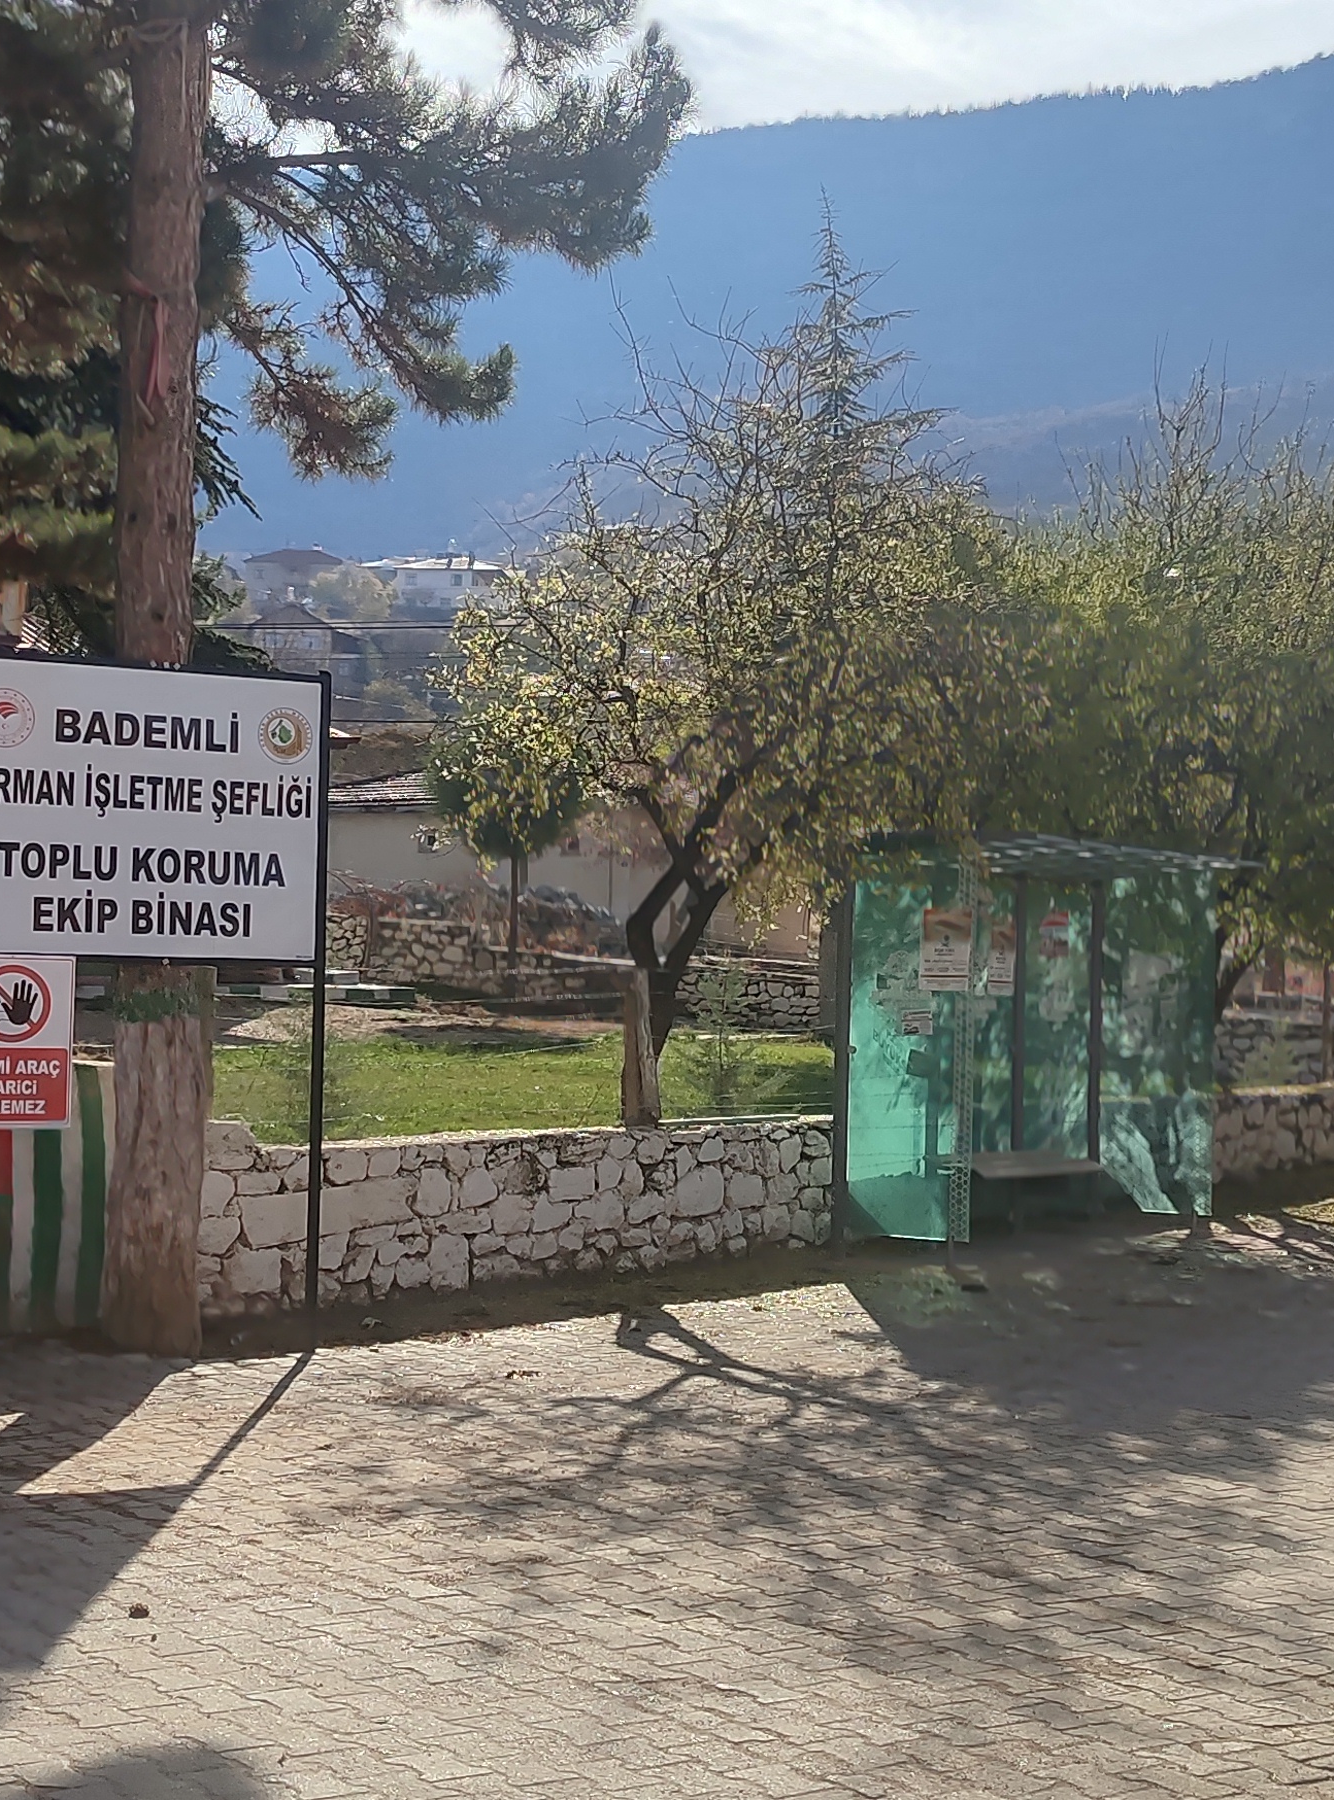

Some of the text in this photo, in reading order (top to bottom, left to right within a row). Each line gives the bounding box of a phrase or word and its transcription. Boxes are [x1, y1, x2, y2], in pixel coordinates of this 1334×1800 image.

[55, 708, 239, 754] BADEMLİ
[85, 763, 203, 818] İŞLETME
[211, 774, 312, 824] ŞEFLİĞİ
[131, 847, 286, 888] KORUMA
[32, 889, 251, 938] EKİP BİNASI
[15, 1059, 61, 1079] ARAÇ
